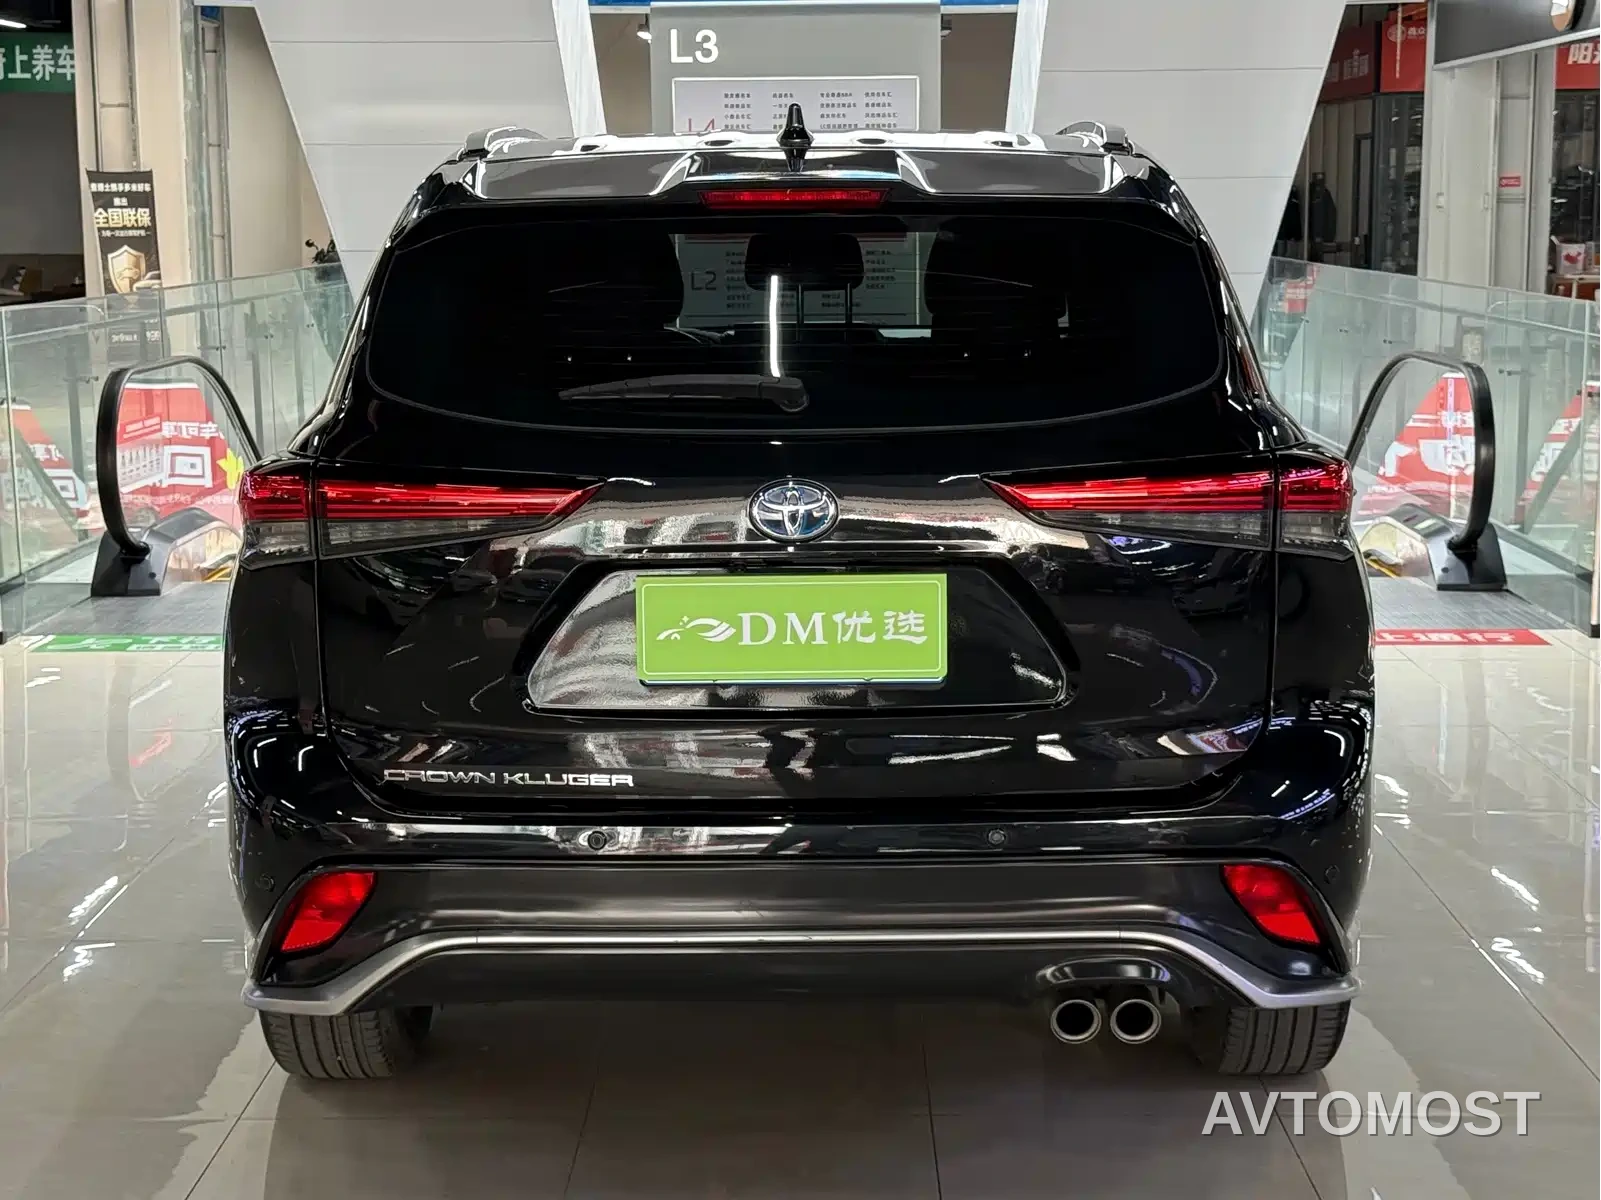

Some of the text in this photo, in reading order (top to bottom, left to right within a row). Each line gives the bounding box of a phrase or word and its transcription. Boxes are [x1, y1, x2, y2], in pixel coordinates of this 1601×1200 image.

[669, 28, 719, 63] L3
[94, 207, 151, 228] 全国联保
[690, 270, 717, 291] L2
[736, 609, 928, 646] DM优选
[383, 769, 635, 787] CROWN KLUGER
